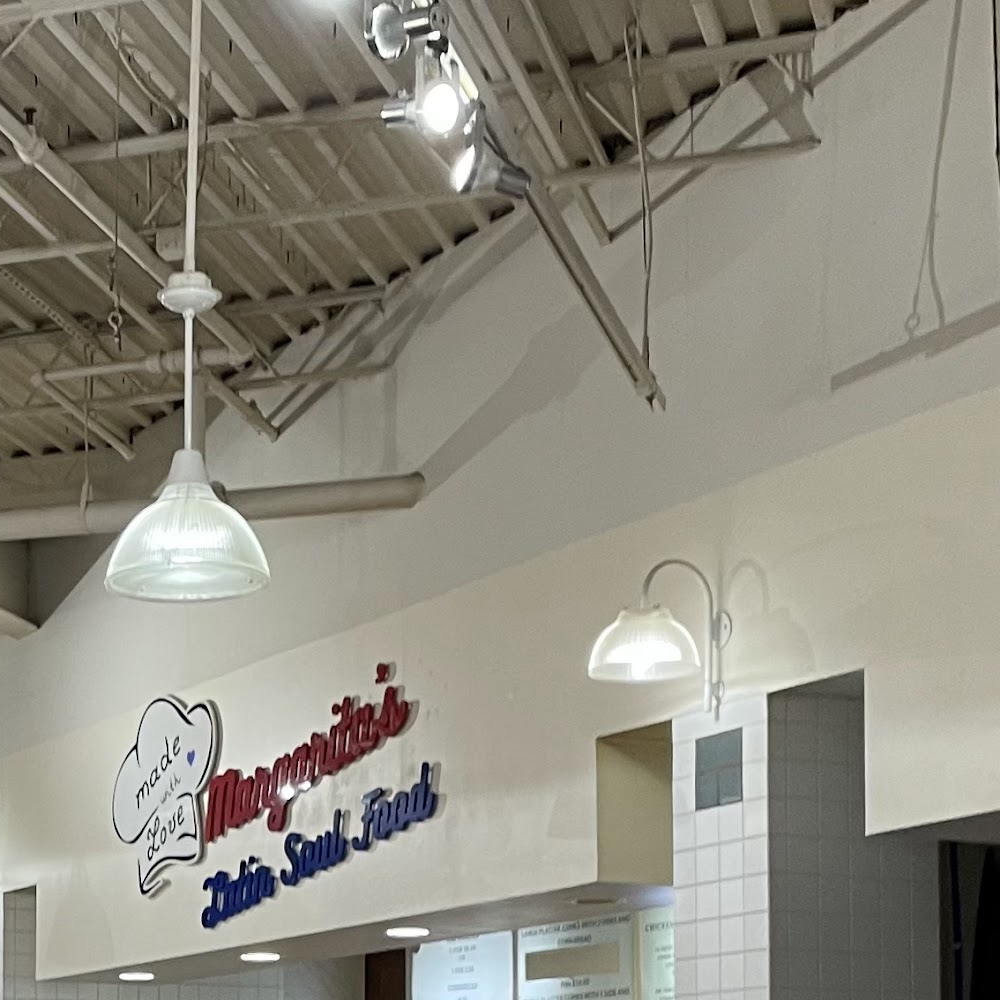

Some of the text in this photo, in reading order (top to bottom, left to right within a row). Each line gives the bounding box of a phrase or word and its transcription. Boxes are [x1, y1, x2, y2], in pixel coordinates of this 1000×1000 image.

[135, 735, 182, 810] made
[203, 662, 410, 844] Margarita's
[146, 804, 185, 861] Love
[201, 761, 438, 929] Latin Soul Food
